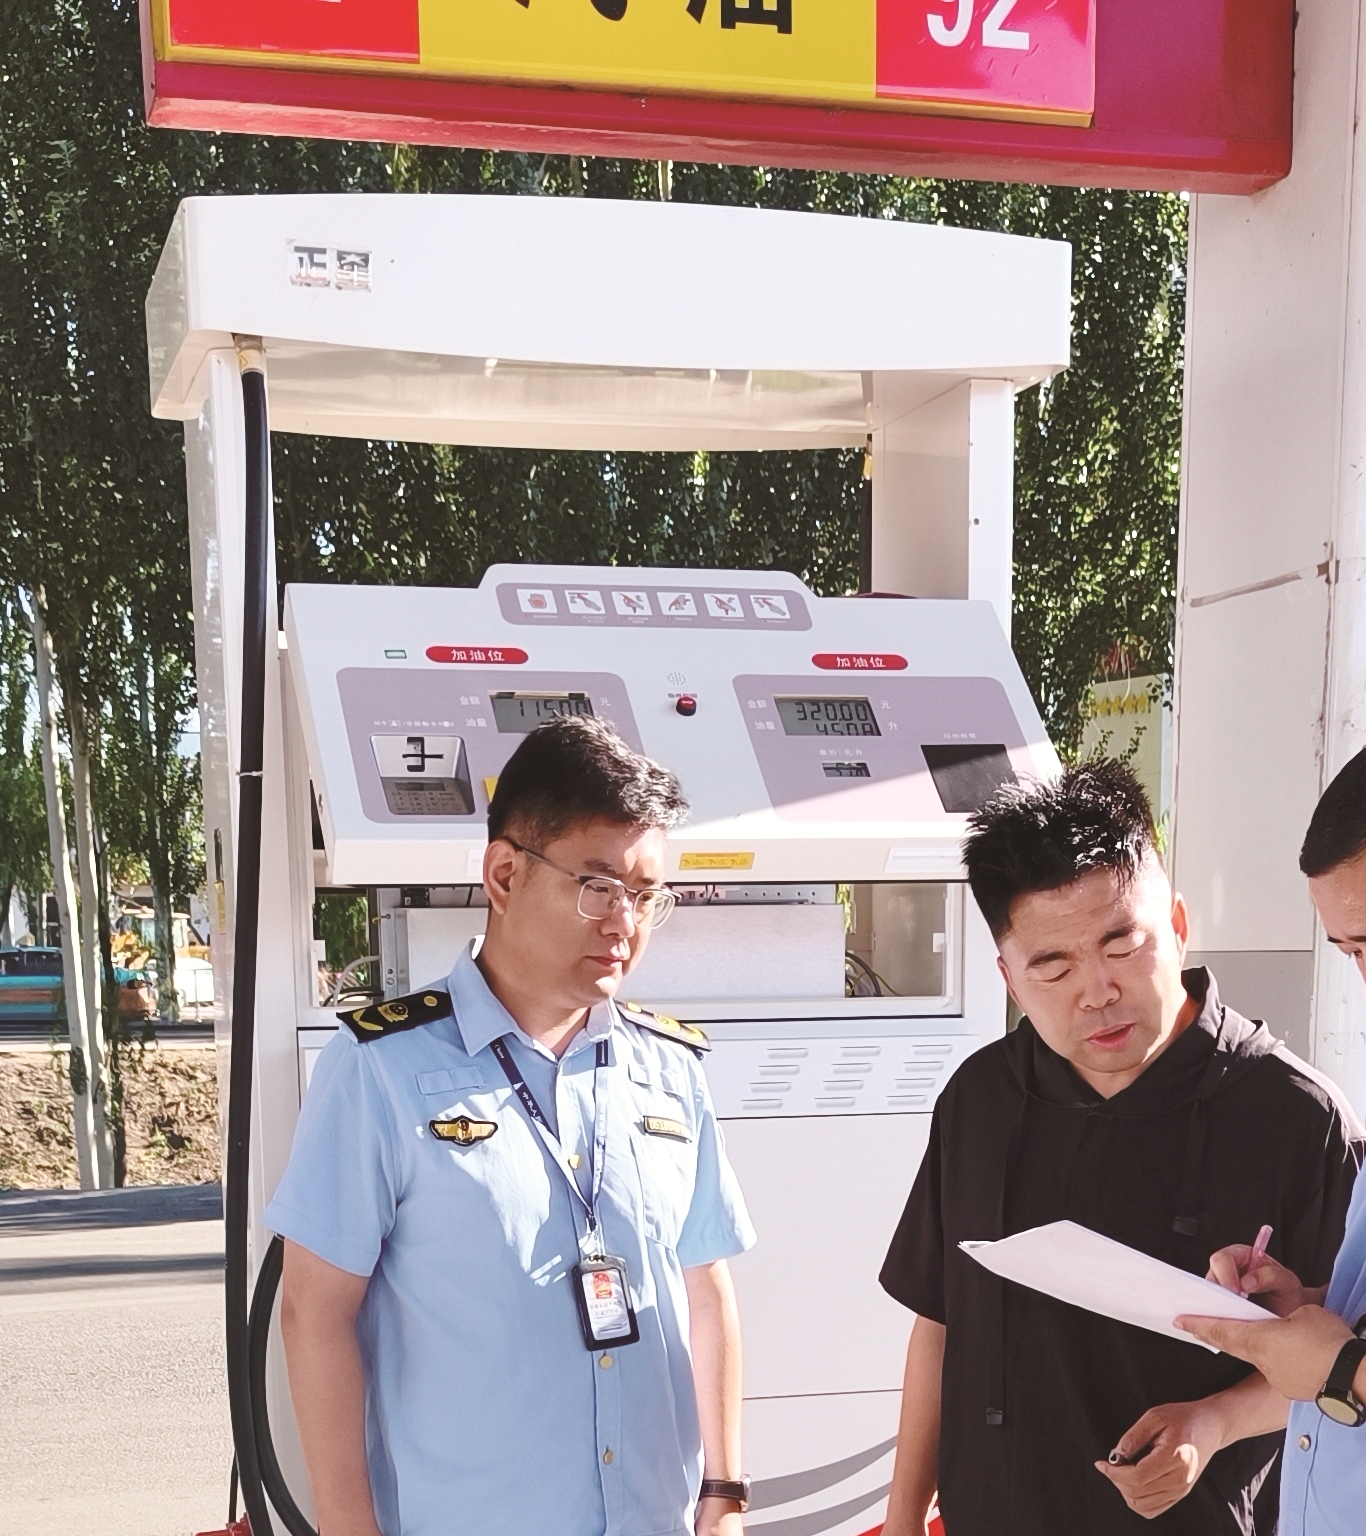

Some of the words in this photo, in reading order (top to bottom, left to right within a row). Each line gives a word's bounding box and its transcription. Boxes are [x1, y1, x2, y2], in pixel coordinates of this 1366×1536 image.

[451, 649, 505, 661] 加油位
[836, 656, 886, 668] 加油位
